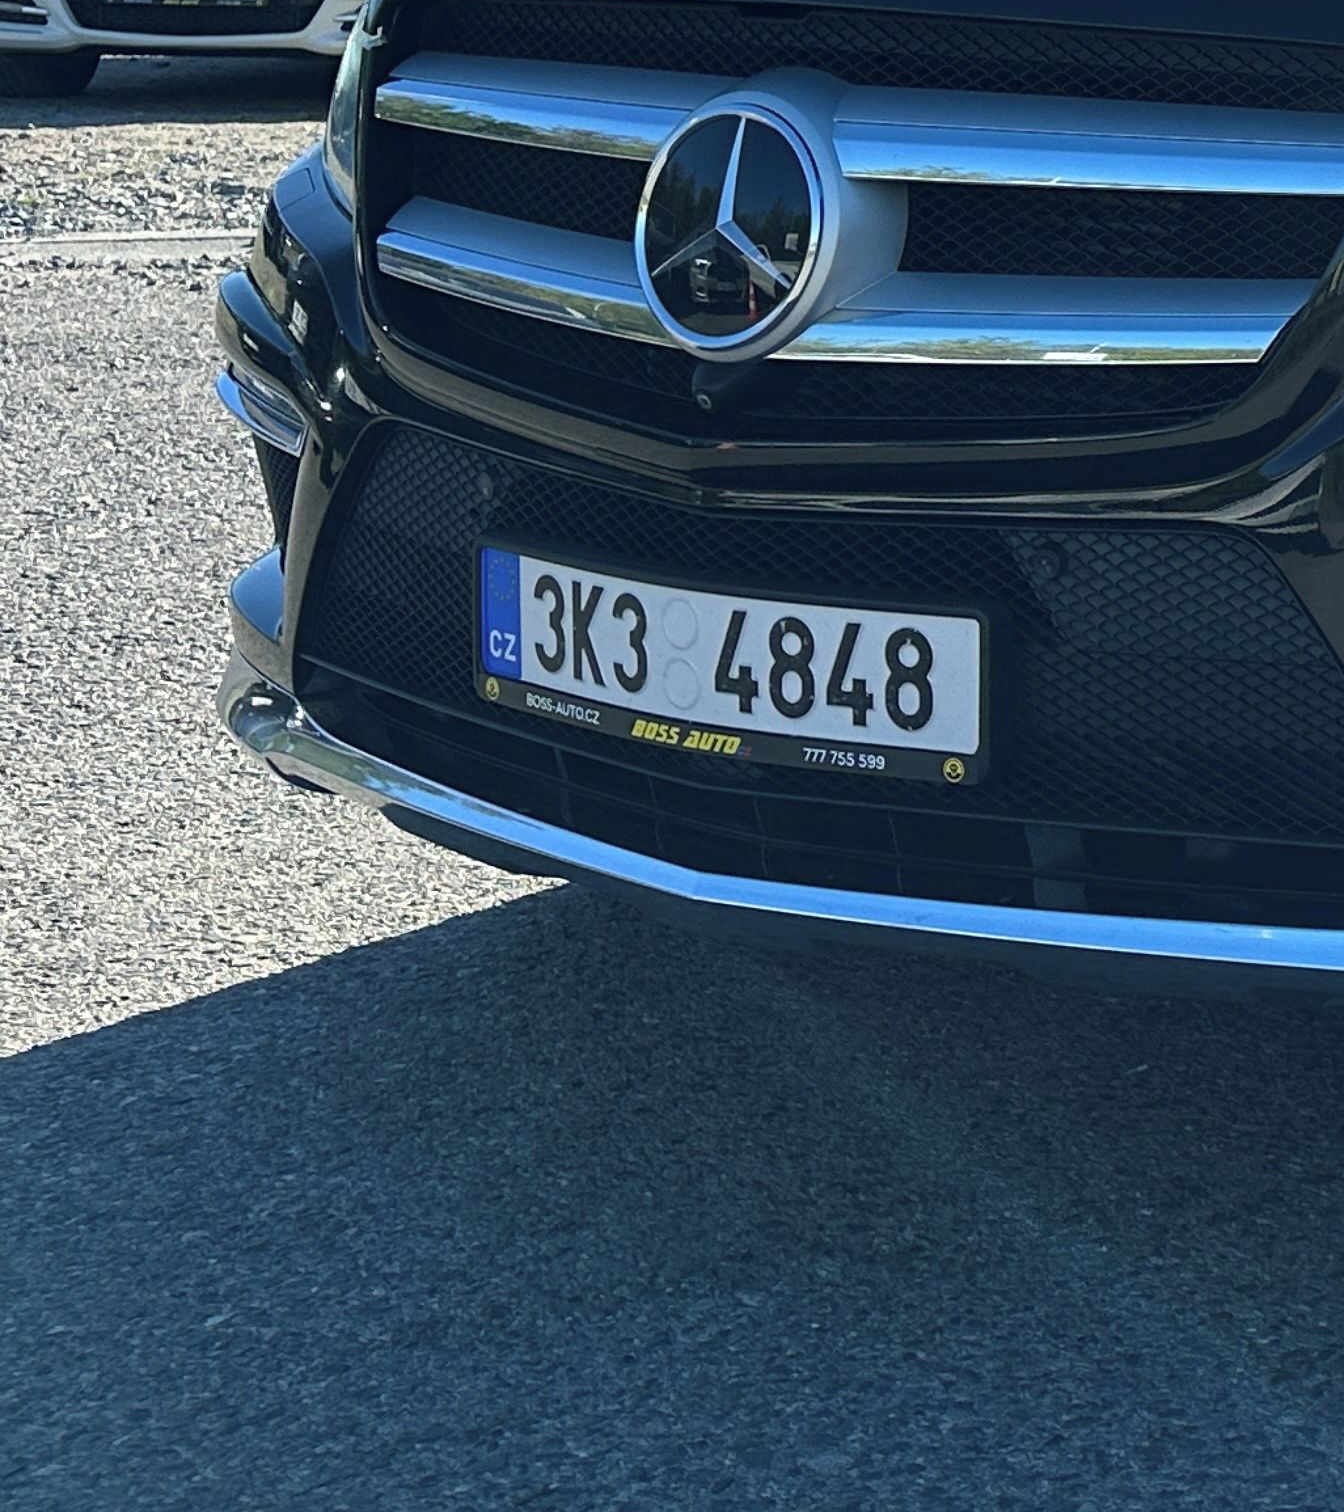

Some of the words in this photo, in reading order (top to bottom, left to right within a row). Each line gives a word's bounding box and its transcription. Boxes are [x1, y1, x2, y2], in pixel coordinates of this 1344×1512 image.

[489, 629, 517, 662] CZ
[534, 573, 648, 692] 3K3
[714, 609, 934, 732] 4848
[526, 692, 601, 726] BOSS-AUTO.CZ
[631, 719, 681, 745] BOSS
[682, 730, 742, 755] AUTO
[803, 747, 827, 762] 777
[830, 750, 855, 767] 755
[858, 755, 886, 770] 599
